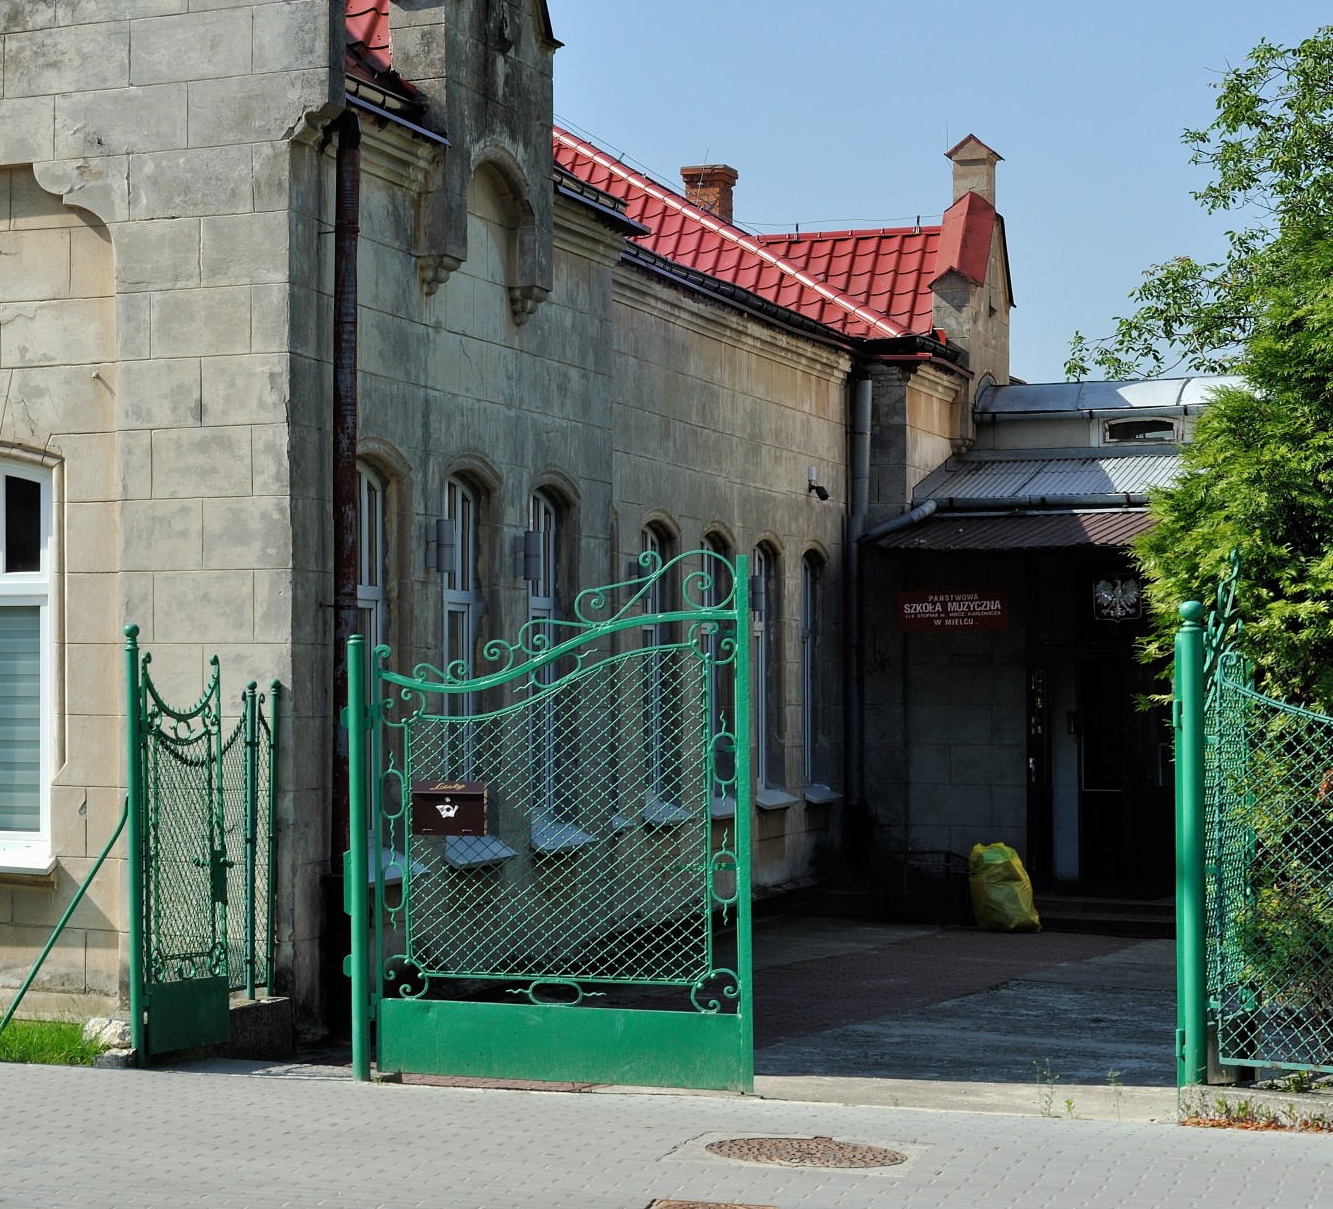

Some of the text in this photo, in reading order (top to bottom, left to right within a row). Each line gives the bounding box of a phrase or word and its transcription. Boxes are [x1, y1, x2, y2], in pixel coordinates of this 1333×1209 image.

[928, 593, 979, 602] PAŃSTWOWA
[903, 599, 1002, 614] SZKOŁA MUZYCZNA
